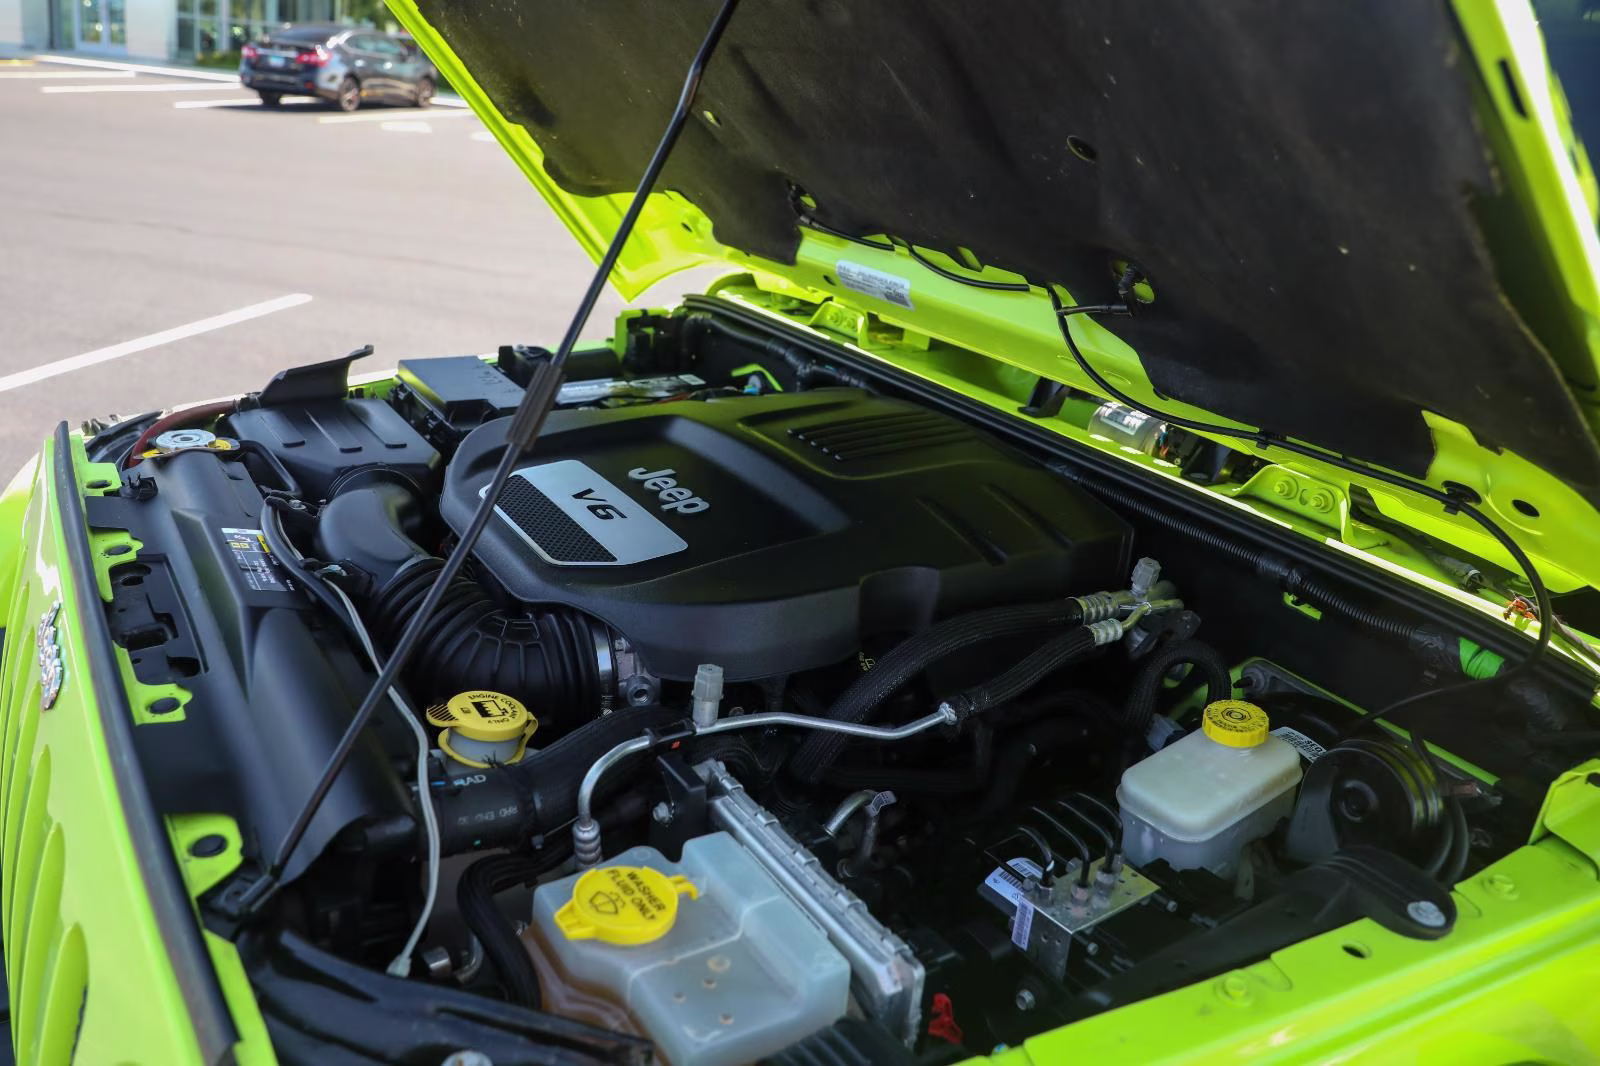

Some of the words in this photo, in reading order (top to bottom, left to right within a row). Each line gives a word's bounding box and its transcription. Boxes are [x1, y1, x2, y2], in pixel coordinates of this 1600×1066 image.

[571, 488, 627, 520] V6
[628, 467, 710, 515] Jeep
[607, 869, 635, 896] FLUID
[631, 897, 657, 920] ONLY
[626, 871, 666, 911] WASHER
